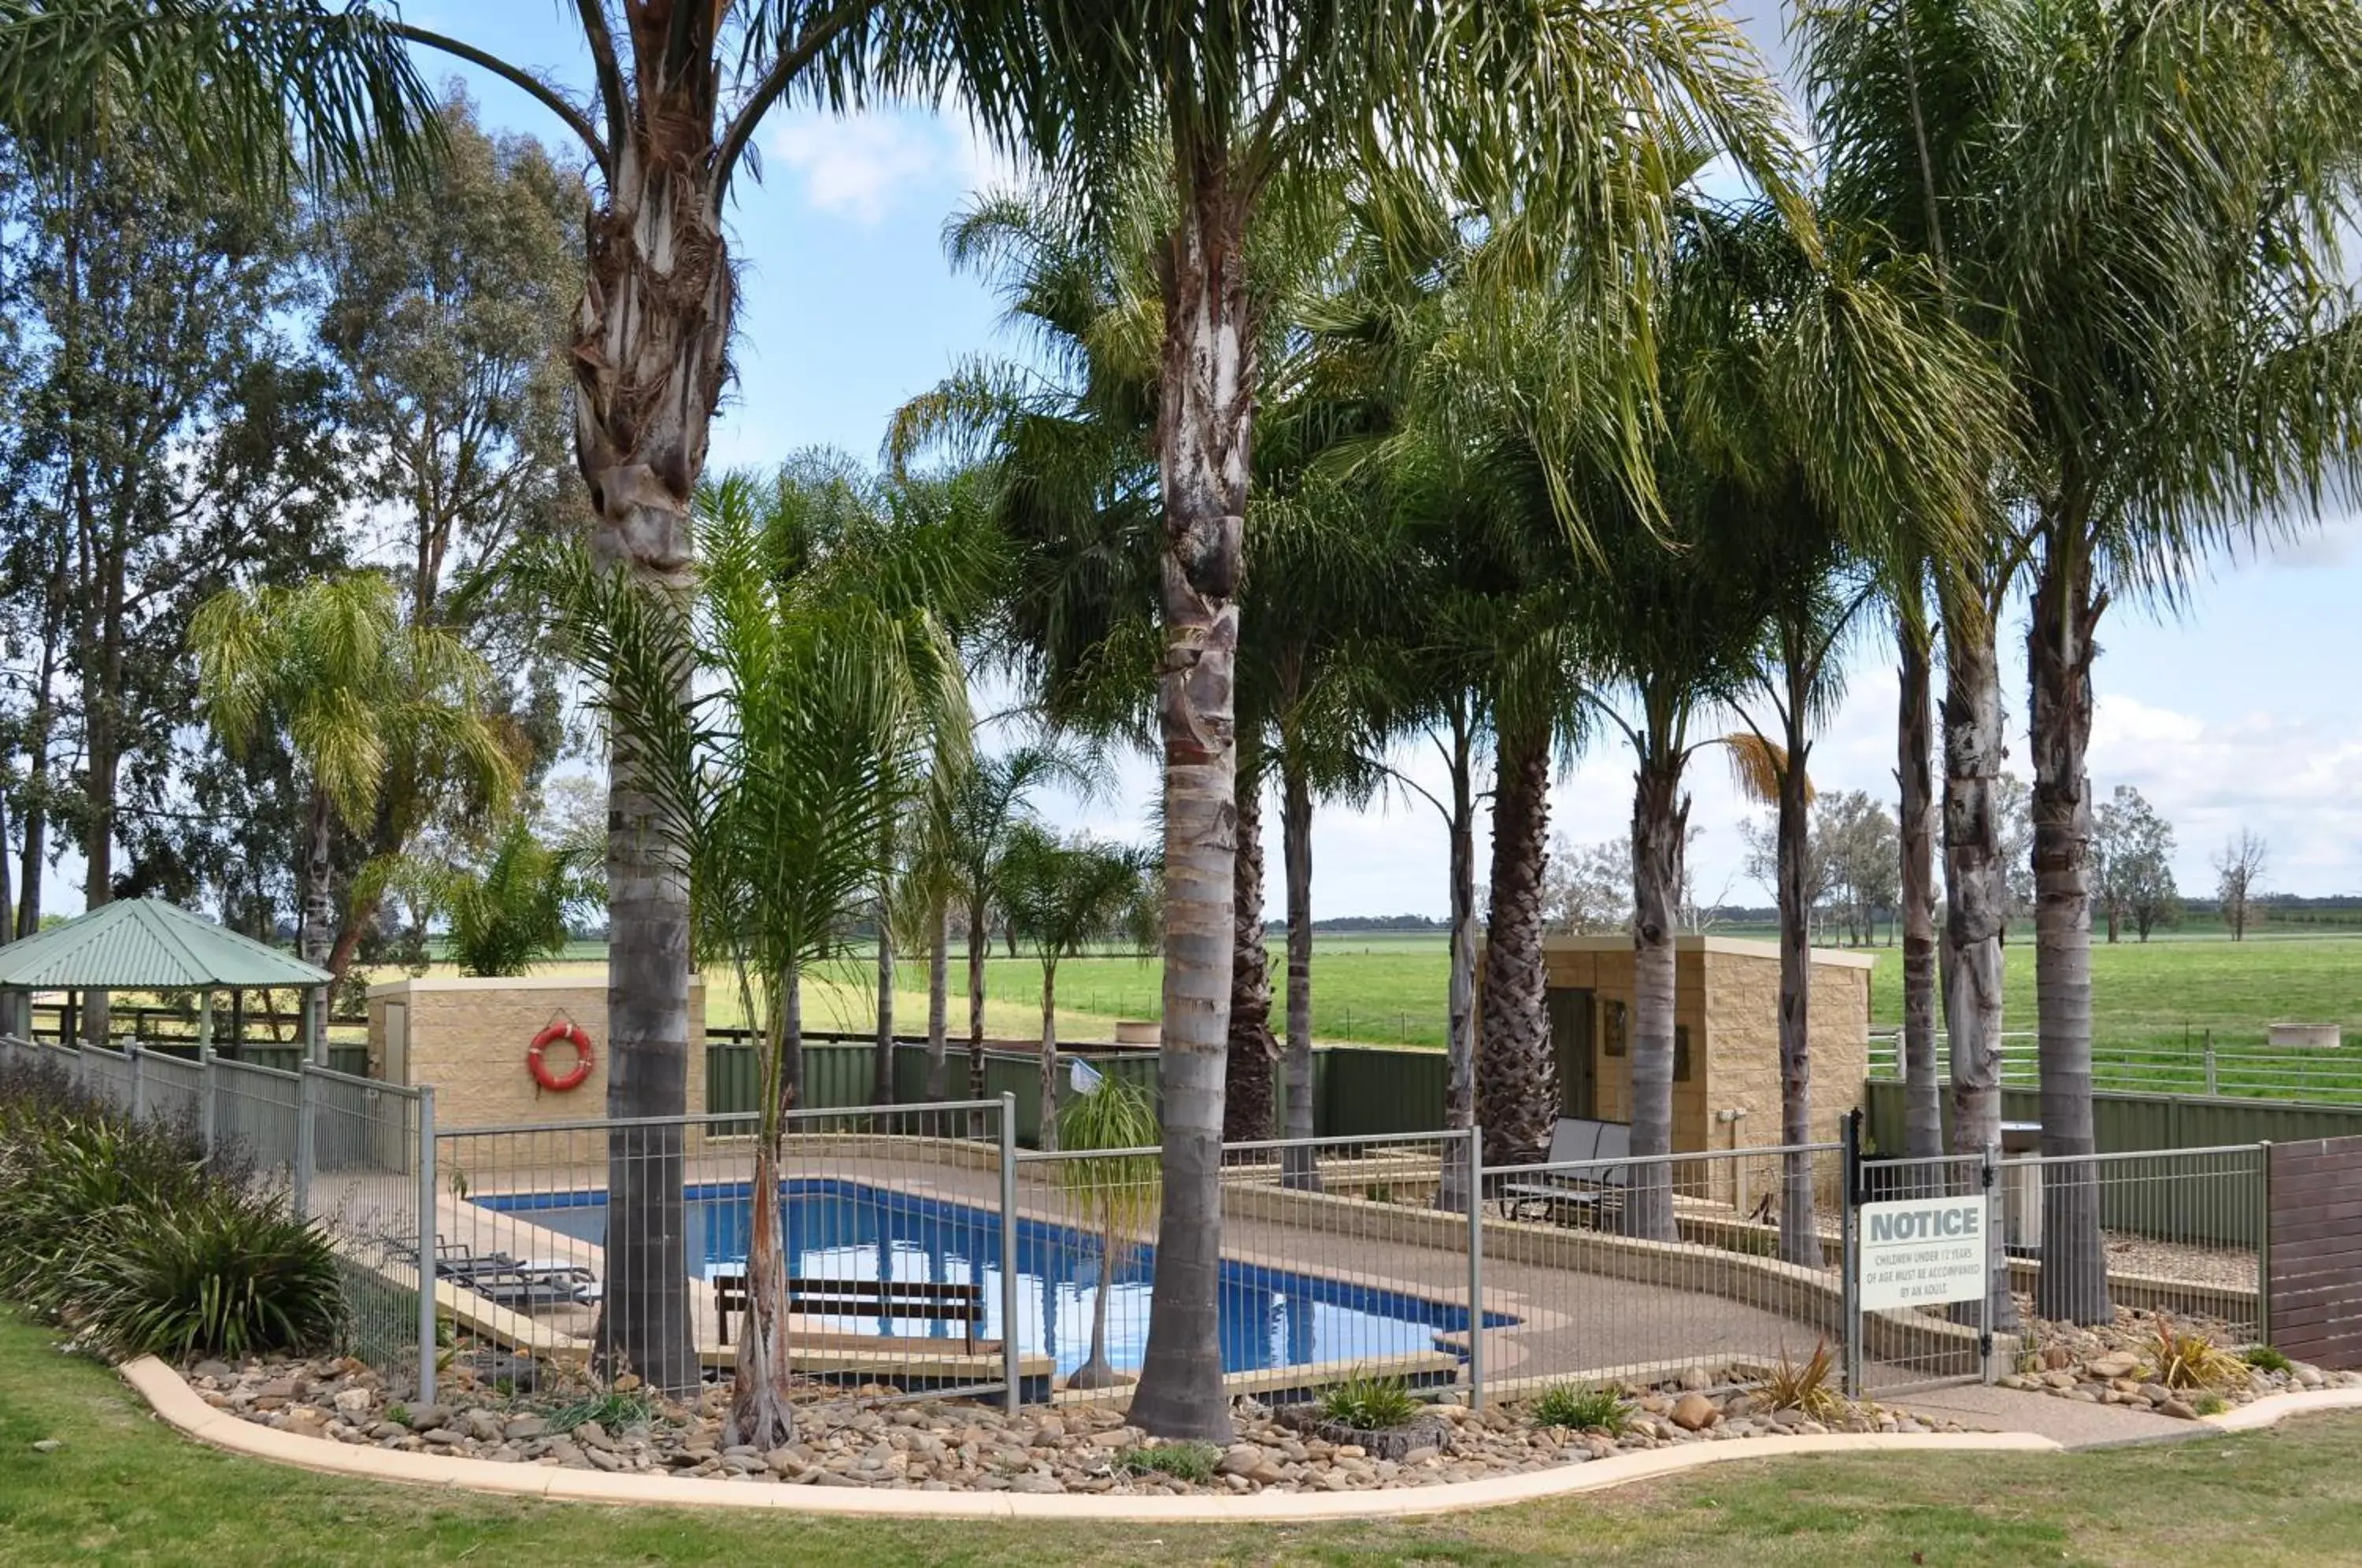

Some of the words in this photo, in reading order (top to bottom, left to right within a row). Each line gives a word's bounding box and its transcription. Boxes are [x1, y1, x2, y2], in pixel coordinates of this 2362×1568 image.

[1871, 1207, 1978, 1241] NOTICE
[1875, 1252, 1912, 1266] CHILDREN
[1914, 1251, 1938, 1263] UNDER
[1951, 1248, 1972, 1260] YEARS
[1867, 1272, 1877, 1284] OF
[1879, 1270, 1893, 1282] AGE
[1895, 1269, 1916, 1281] MUST
[1917, 1267, 1926, 1279] BE
[1928, 1263, 1980, 1278] ACCOMPANIED
[1900, 1287, 1909, 1298] BY
[1911, 1285, 1922, 1296] AN
